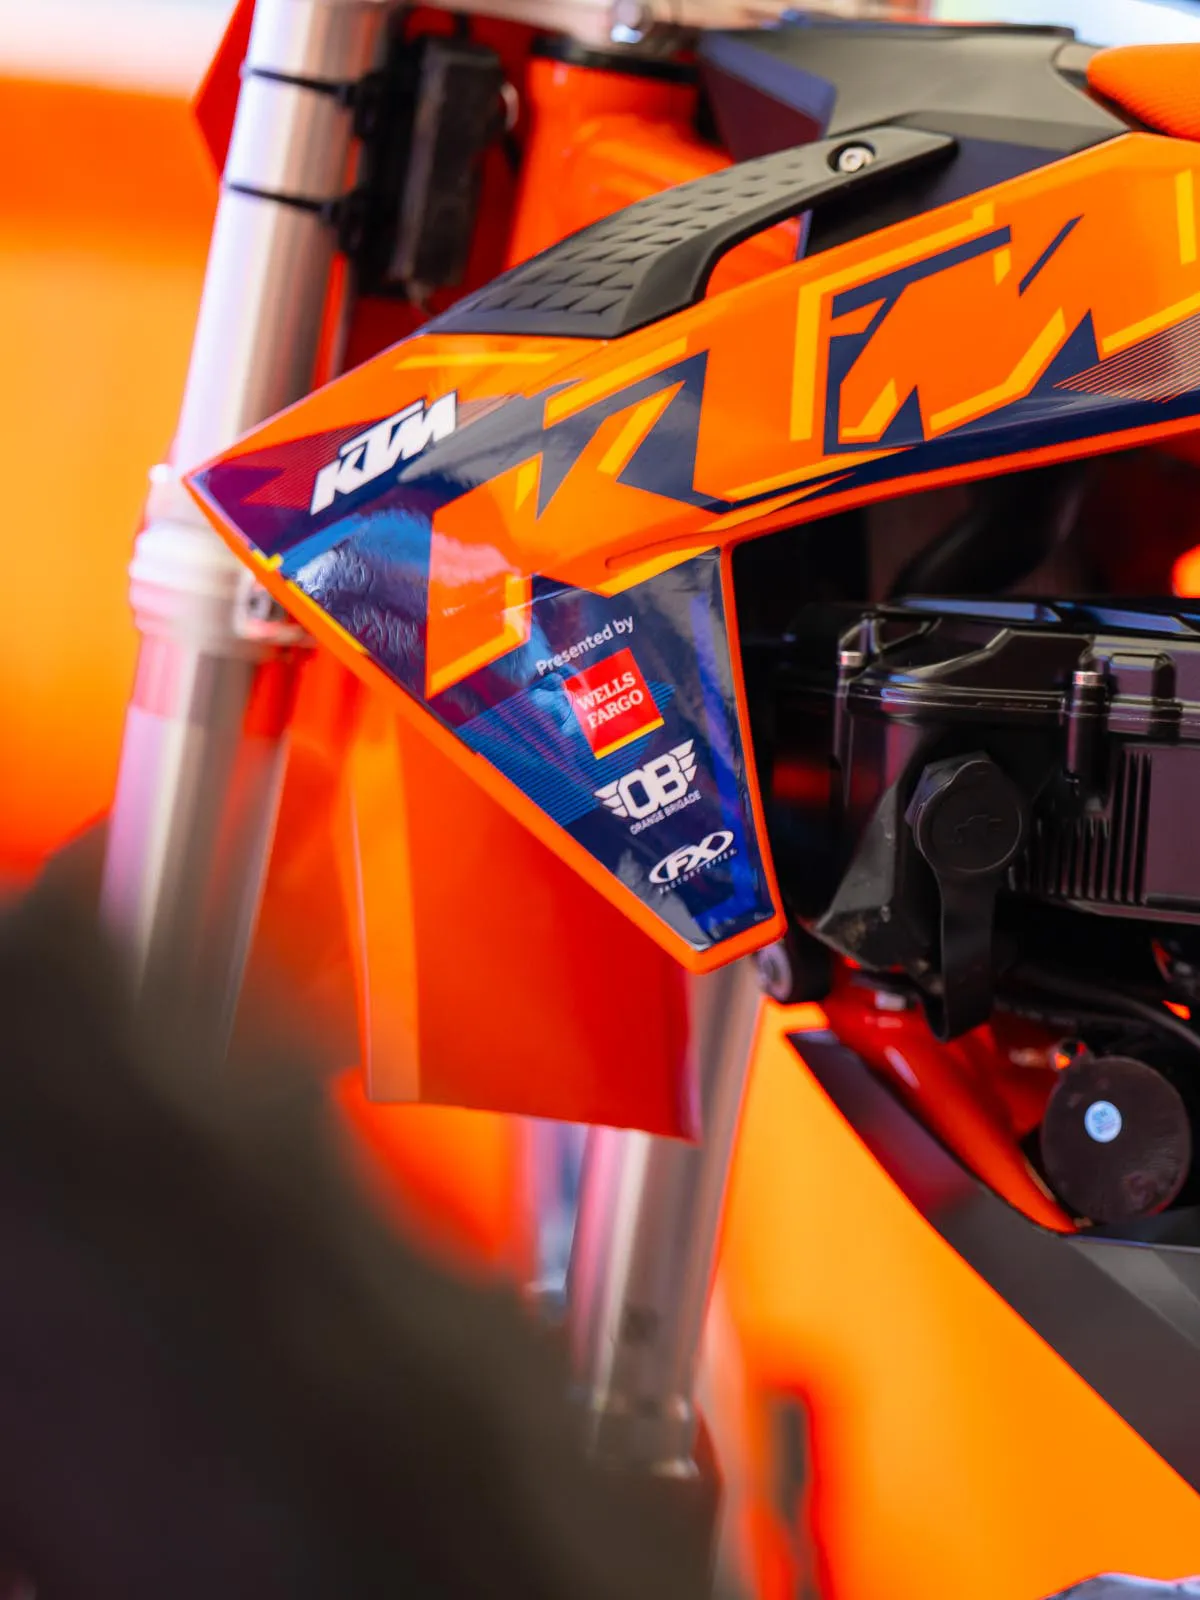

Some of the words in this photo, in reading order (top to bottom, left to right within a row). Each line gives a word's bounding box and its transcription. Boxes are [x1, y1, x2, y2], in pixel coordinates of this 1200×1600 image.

[310, 391, 456, 516] KTM
[535, 623, 614, 676] Presented
[612, 616, 634, 634] by
[576, 671, 636, 711] WELLS
[586, 688, 644, 729] FARGO
[618, 753, 688, 819] OB
[630, 812, 665, 836] ORANGE
[664, 790, 702, 817] BRIGADE
